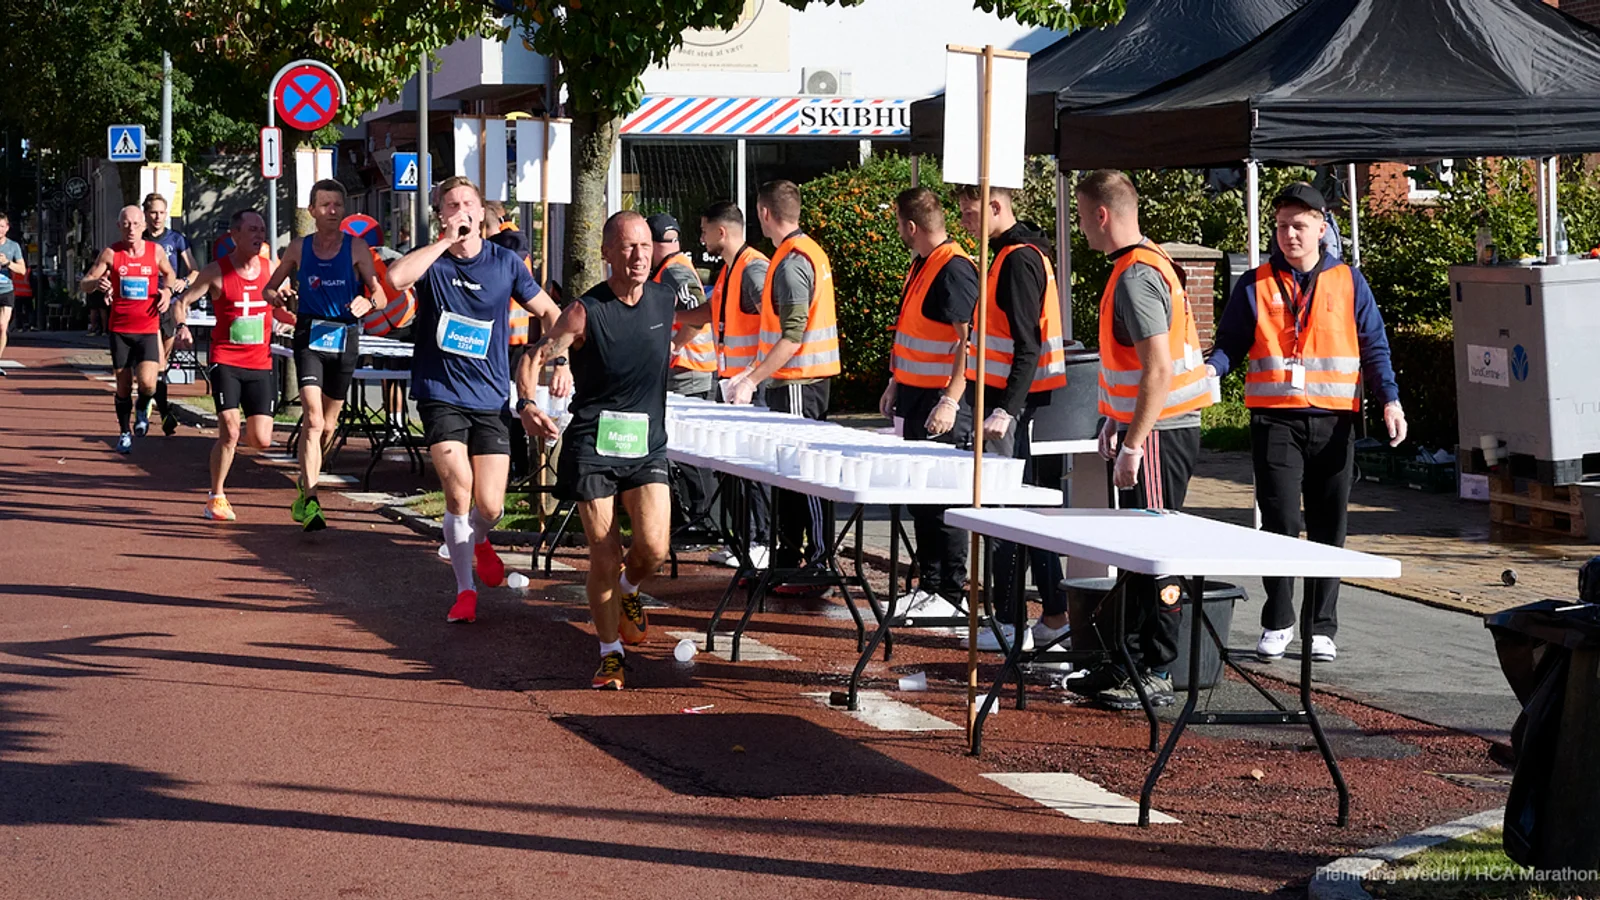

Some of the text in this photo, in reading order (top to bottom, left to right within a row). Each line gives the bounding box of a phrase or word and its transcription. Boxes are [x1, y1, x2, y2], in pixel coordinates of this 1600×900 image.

[801, 106, 910, 127] SKIBHU
[448, 331, 485, 347] Joachim
[608, 431, 638, 442] Martin
